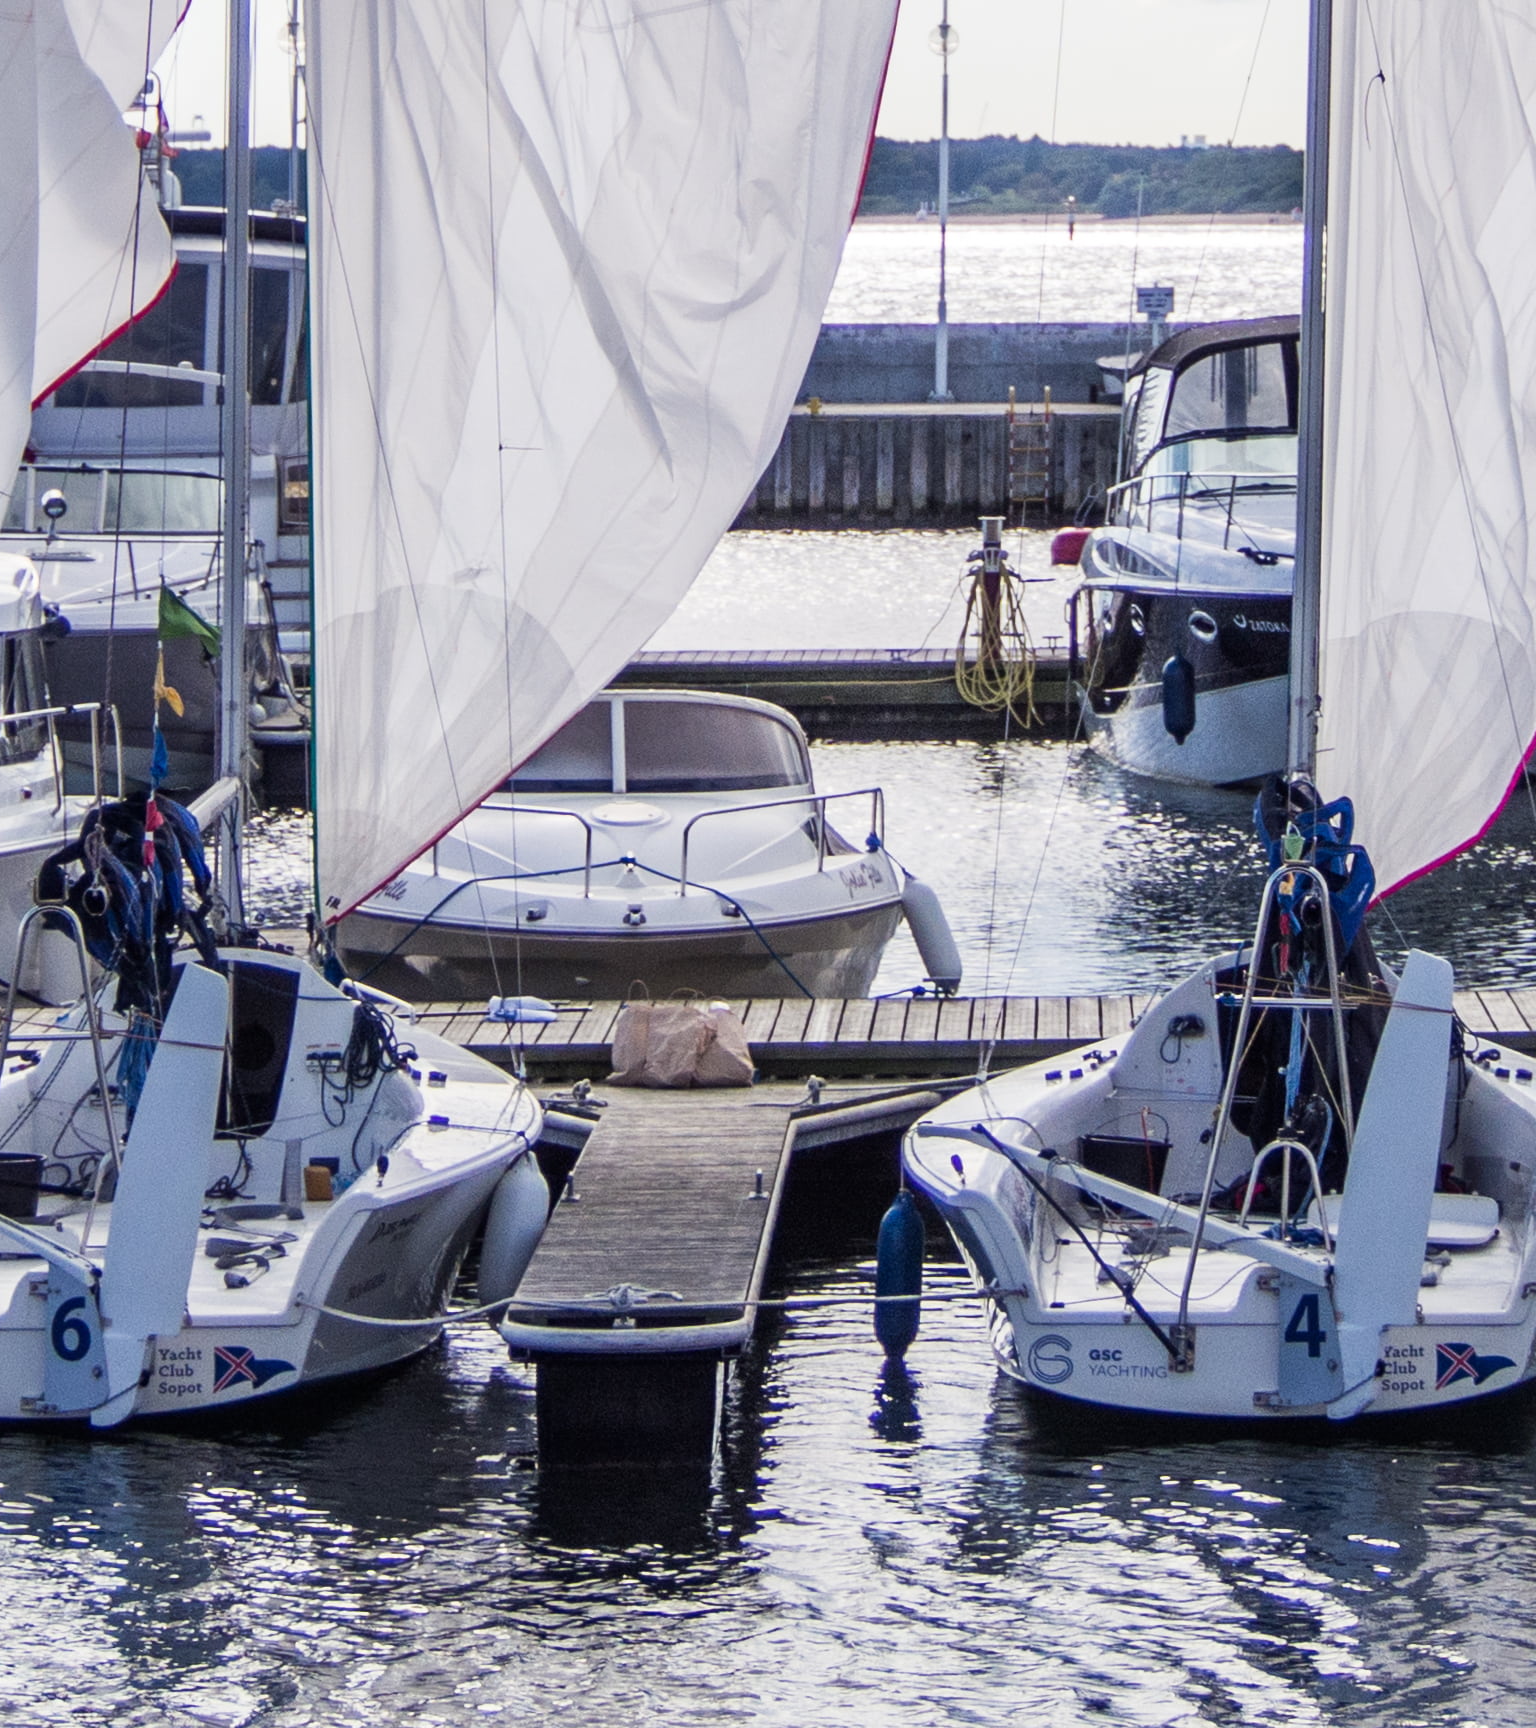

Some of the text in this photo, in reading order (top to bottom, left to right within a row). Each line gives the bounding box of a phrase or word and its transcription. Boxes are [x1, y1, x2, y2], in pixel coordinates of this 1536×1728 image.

[51, 1296, 92, 1361] 6
[1284, 1293, 1327, 1358] 4
[158, 1348, 202, 1364] Yacht
[1089, 1349, 1123, 1361] GSC
[1382, 1344, 1424, 1361] Yacht
[158, 1364, 194, 1378] Club
[1088, 1365, 1168, 1379] YACHTING
[158, 1381, 203, 1397] Sopot
[1381, 1378, 1425, 1394] Sopot
